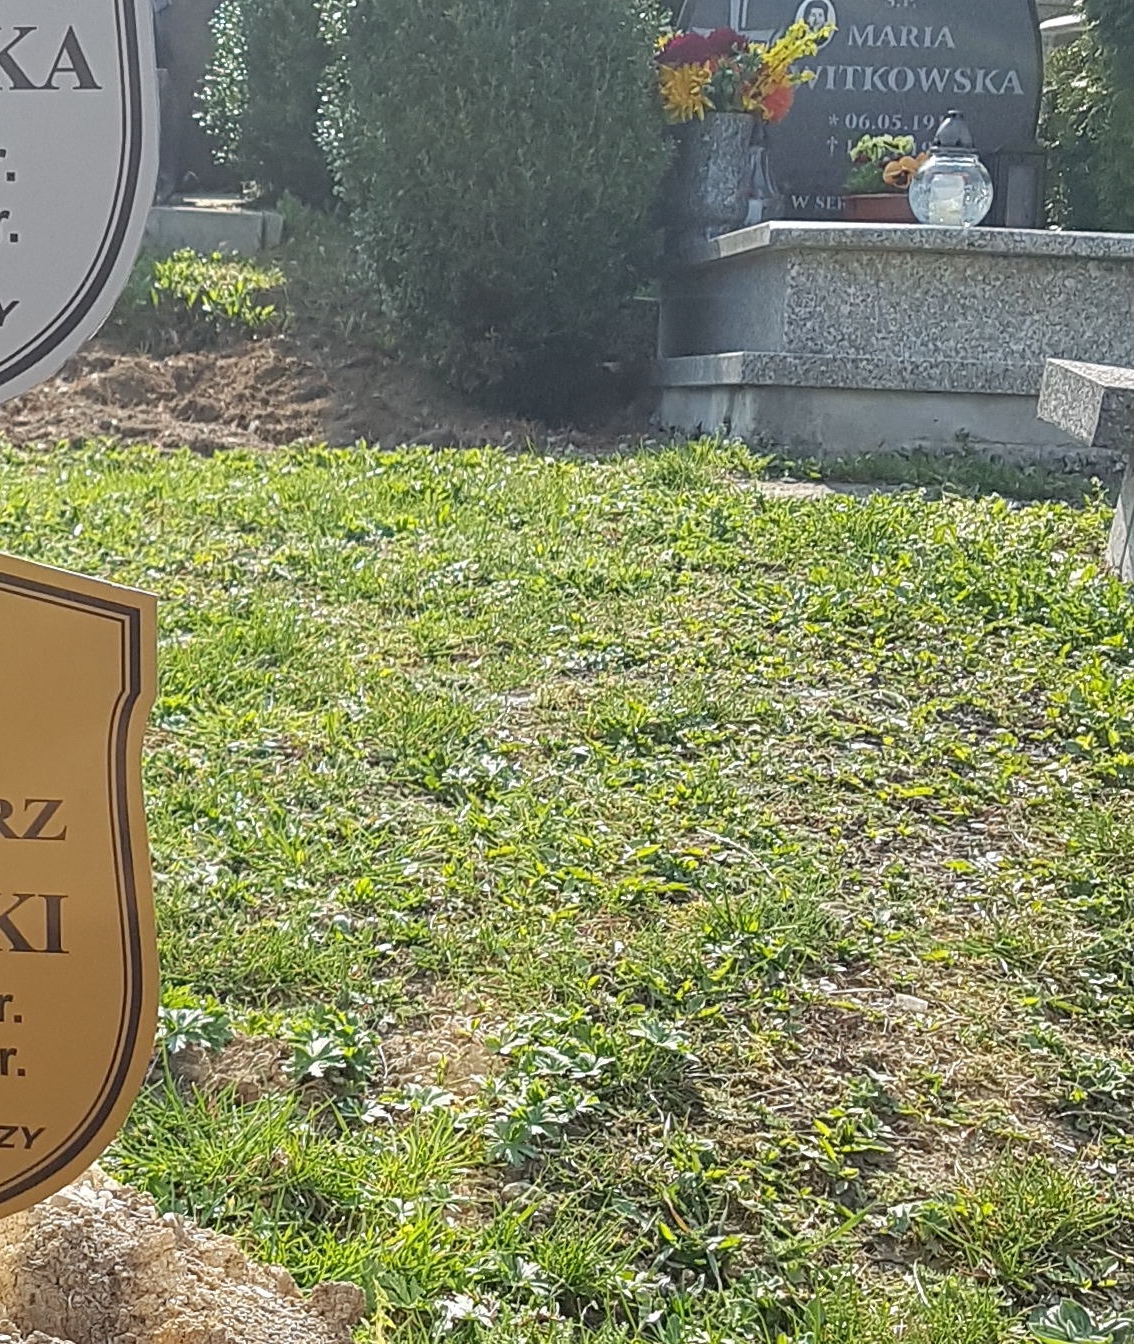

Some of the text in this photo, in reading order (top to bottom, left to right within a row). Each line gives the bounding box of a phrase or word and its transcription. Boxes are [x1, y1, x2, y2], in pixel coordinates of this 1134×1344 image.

[847, 23, 956, 49] MARIA
[844, 112, 941, 131] 06.05.19
[791, 193, 812, 211] W
